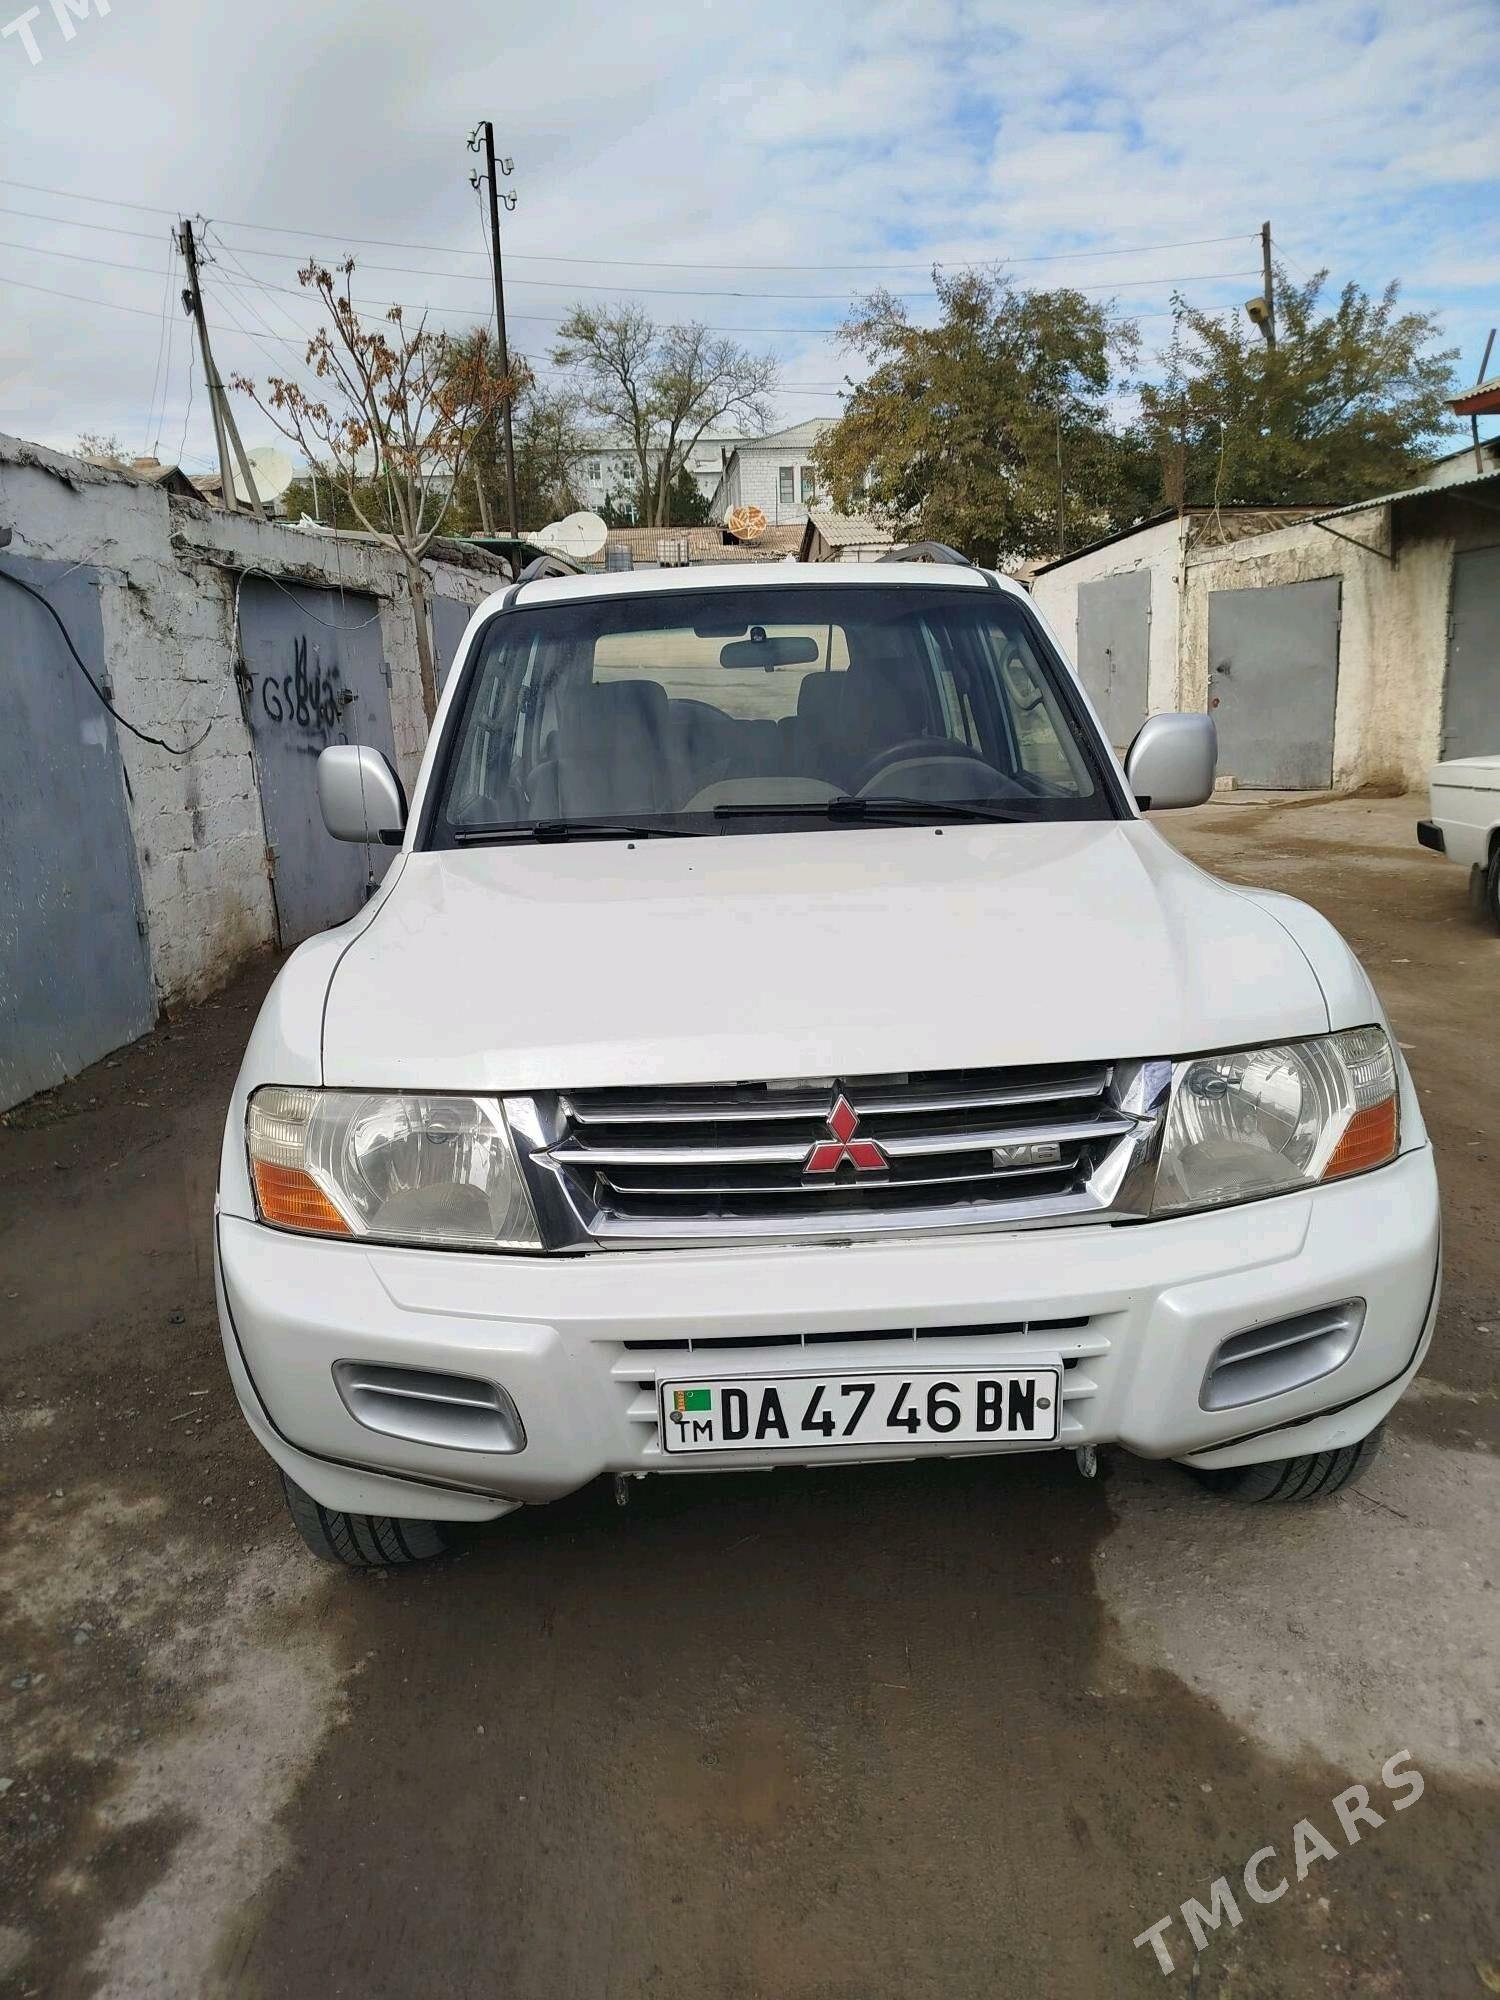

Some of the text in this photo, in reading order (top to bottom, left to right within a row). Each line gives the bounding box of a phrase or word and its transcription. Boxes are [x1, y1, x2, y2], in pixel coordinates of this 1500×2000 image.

[992, 1143, 1060, 1167] V6
[721, 1387, 790, 1441] DA
[976, 1379, 1036, 1433] BN
[677, 1419, 713, 1443] TM
